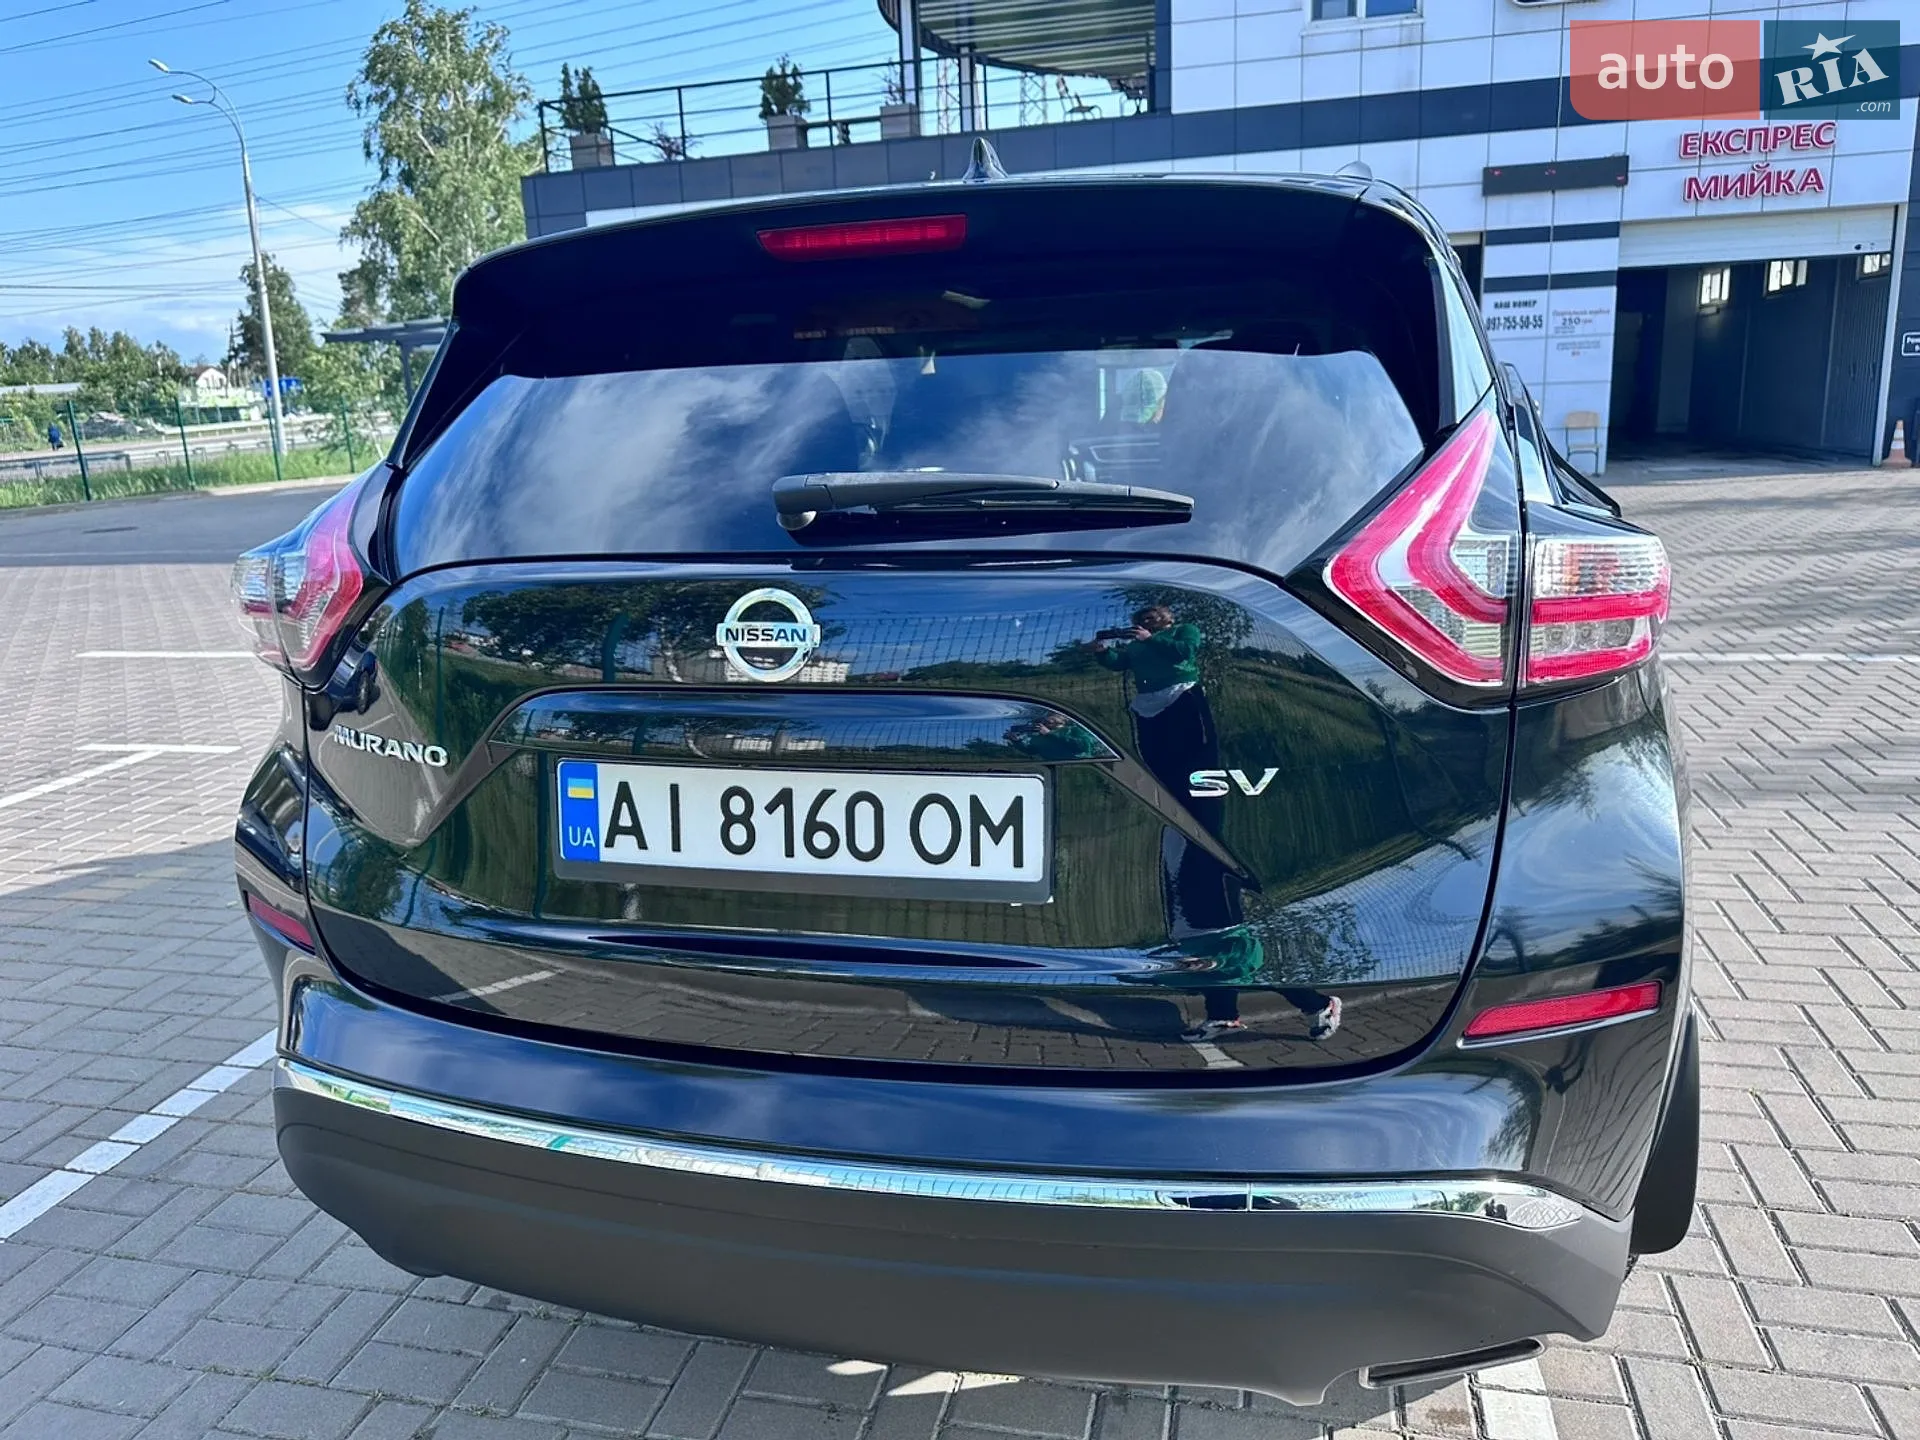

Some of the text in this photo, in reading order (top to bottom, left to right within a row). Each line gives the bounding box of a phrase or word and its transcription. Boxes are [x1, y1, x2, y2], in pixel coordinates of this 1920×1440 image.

[1679, 121, 1837, 158] ЕКСПРЕС
[1682, 162, 1825, 202] МИЙКА
[725, 627, 807, 643] NISSAN
[334, 724, 449, 768] MURANO
[1188, 767, 1280, 797] SV
[568, 826, 597, 848] UA
[604, 780, 1024, 869] AI 8160 OM
